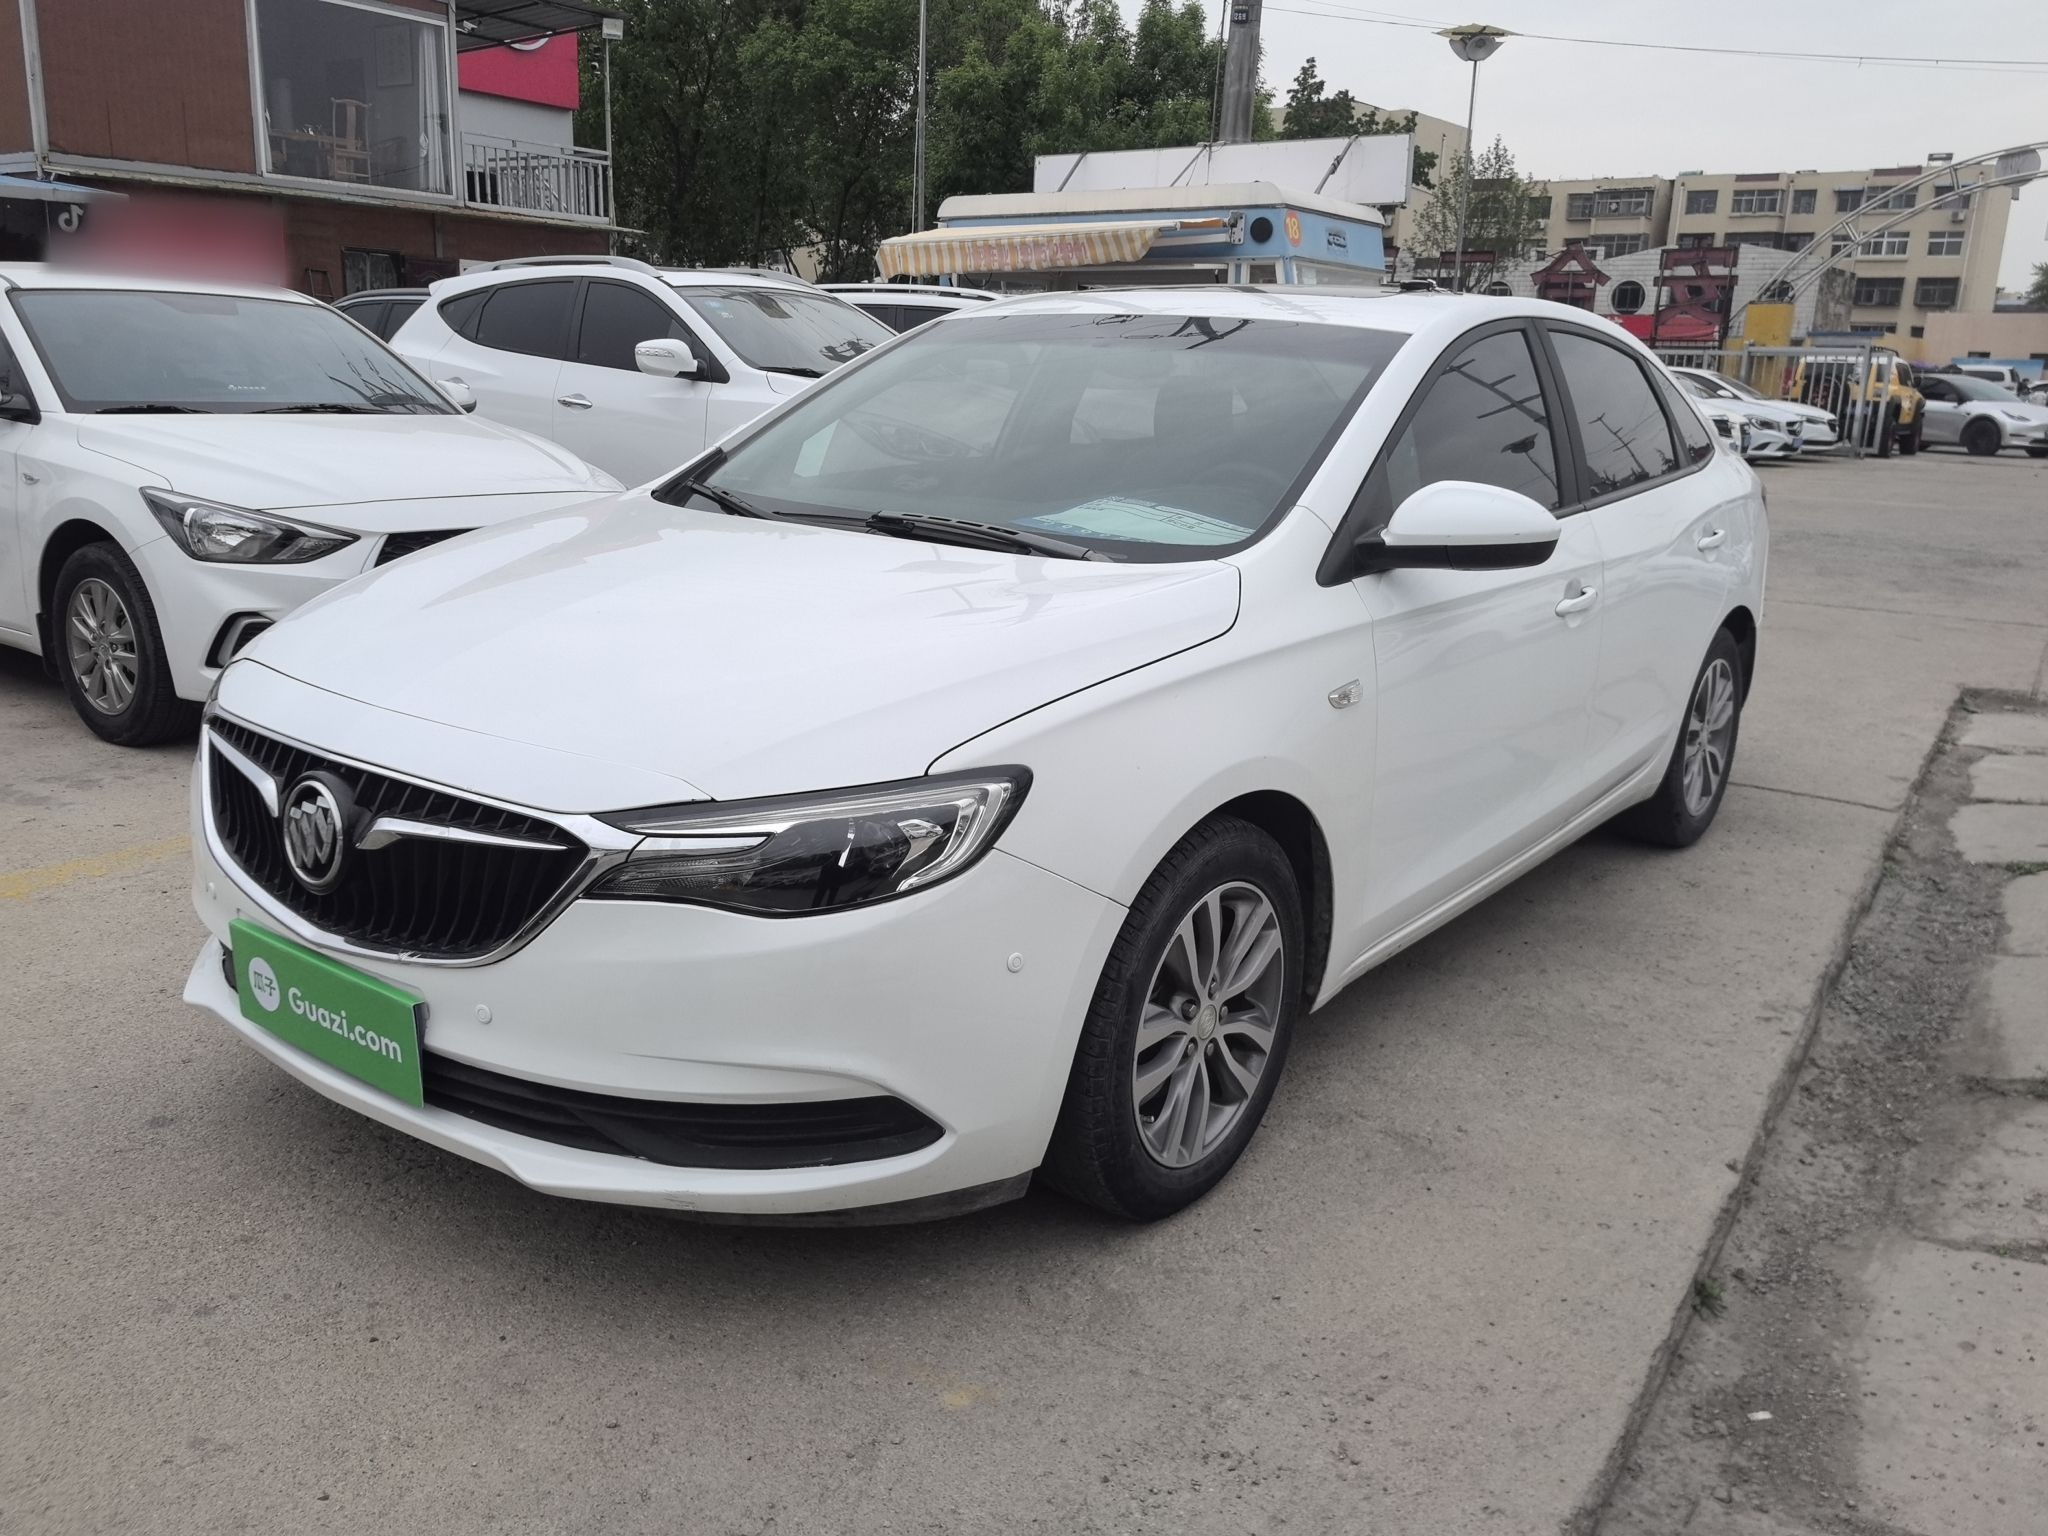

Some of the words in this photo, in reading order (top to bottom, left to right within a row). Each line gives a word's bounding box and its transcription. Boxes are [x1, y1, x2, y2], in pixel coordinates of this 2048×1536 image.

[1286, 217, 1299, 239] 18
[253, 971, 276, 997] 瓜子
[288, 986, 402, 1063] Guazi.com
